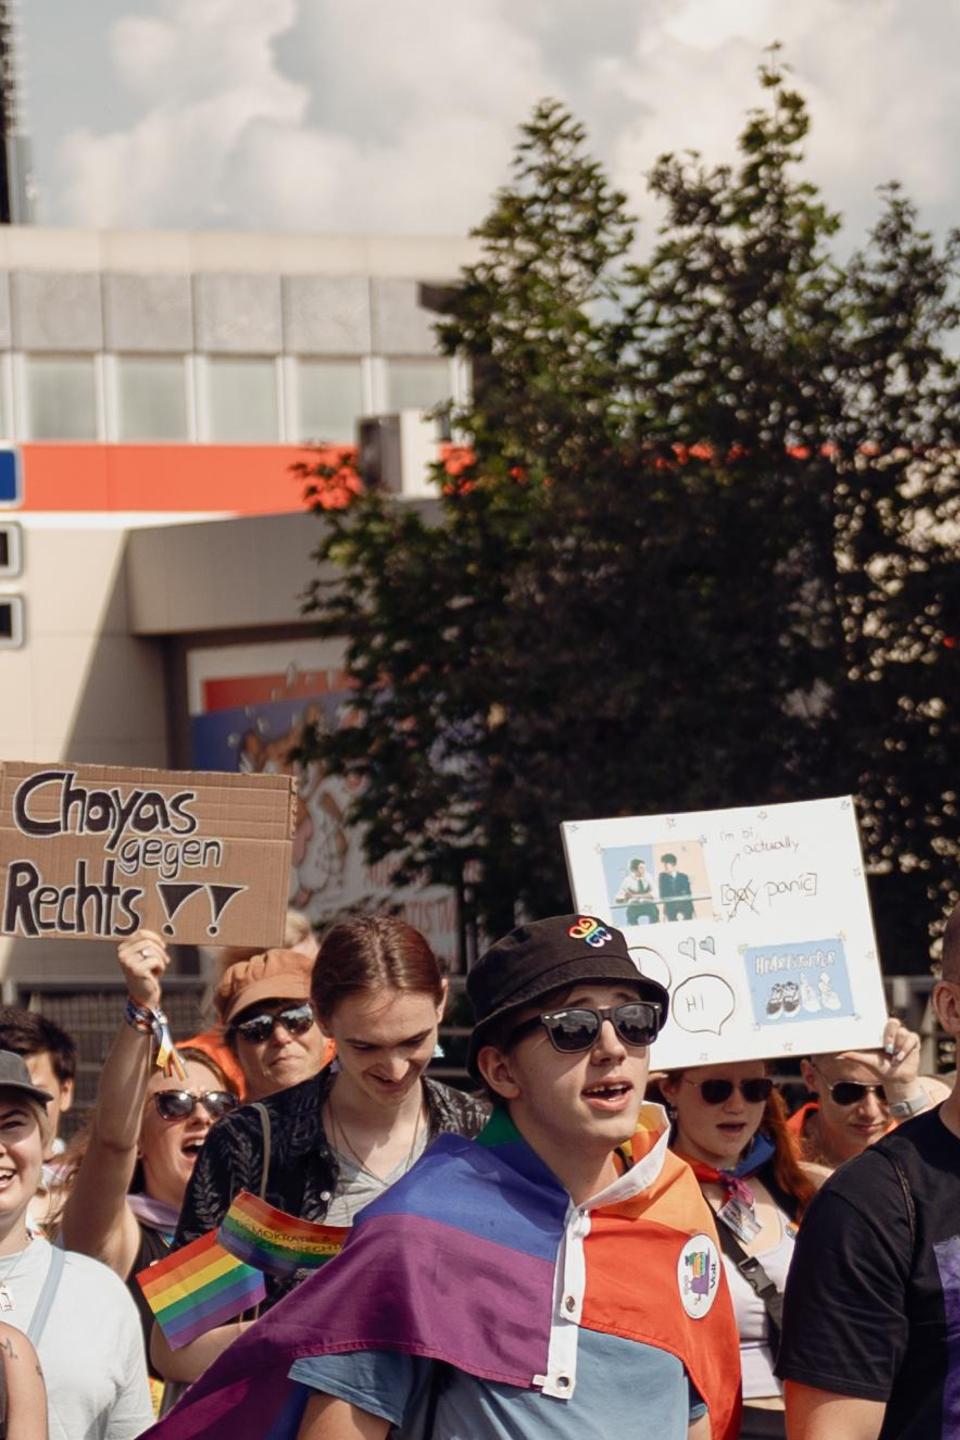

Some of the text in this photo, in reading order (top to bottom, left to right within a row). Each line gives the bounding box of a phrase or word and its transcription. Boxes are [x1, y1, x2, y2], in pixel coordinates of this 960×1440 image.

[14, 770, 198, 850] Chayas
[118, 838, 222, 878] gegen
[743, 834, 799, 855] actually
[3, 859, 143, 937] Rechts
